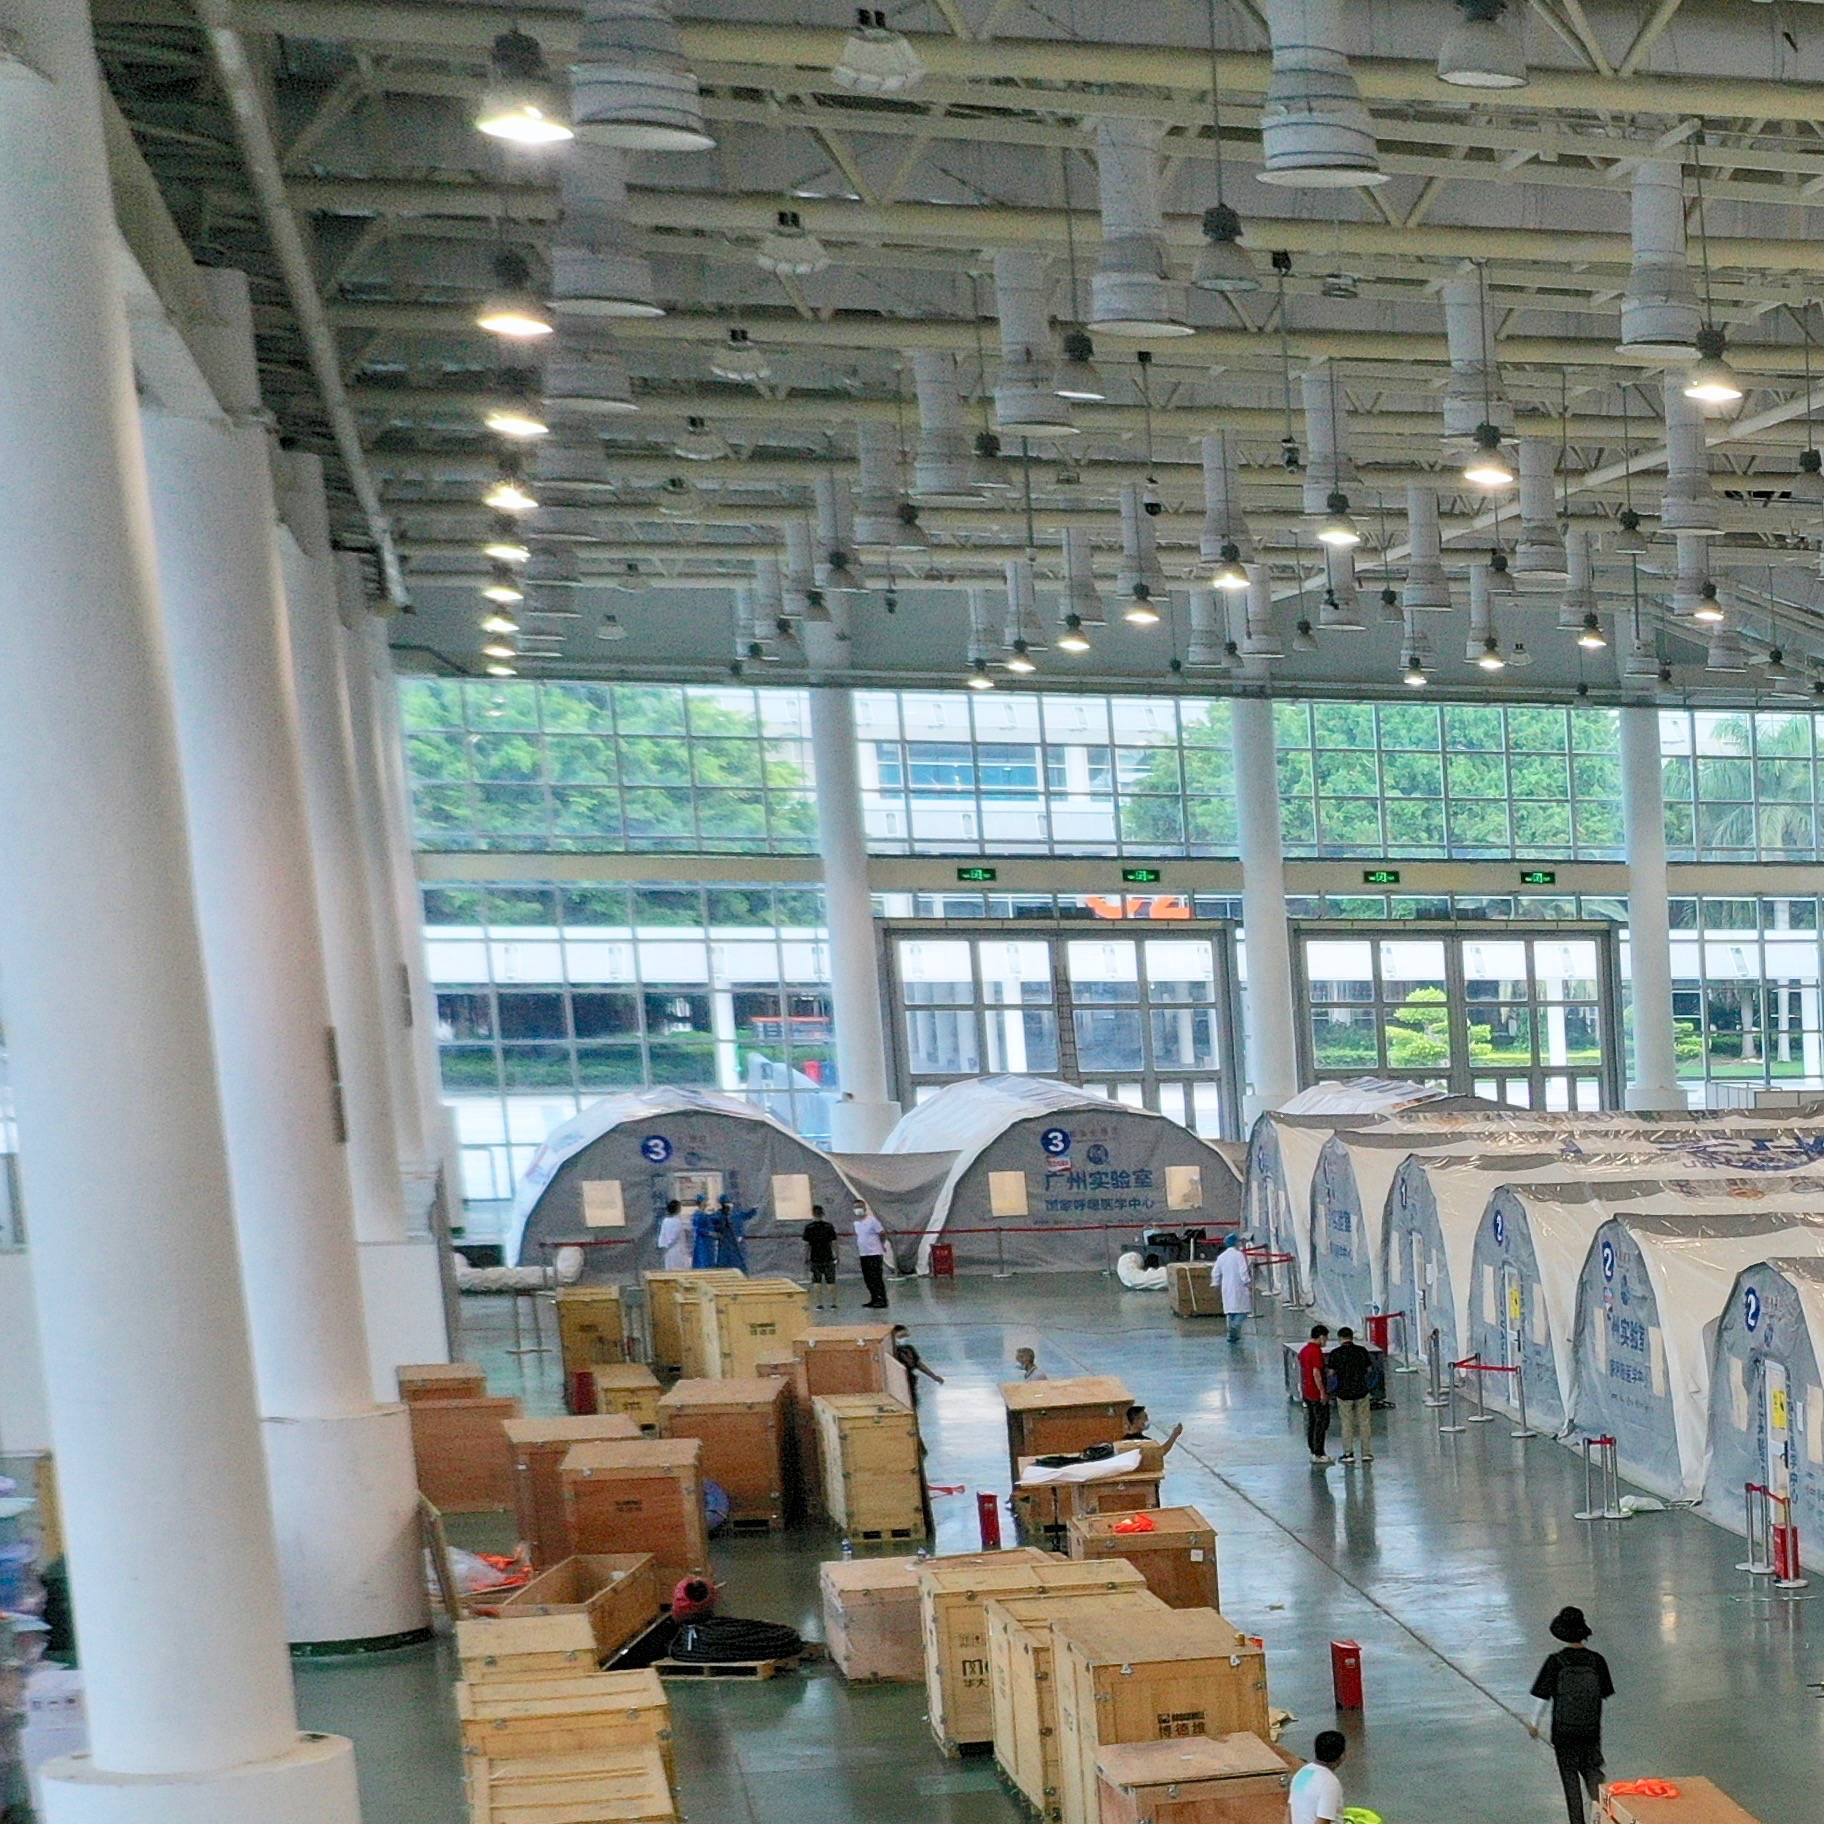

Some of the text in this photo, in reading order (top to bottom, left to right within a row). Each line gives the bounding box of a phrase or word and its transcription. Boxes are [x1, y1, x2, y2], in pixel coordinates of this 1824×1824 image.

[648, 1139, 666, 1160] 3
[1047, 1131, 1066, 1153] 3
[1044, 1168, 1153, 1191] 广州实验室
[1604, 1248, 1613, 1277] 2
[1748, 1294, 1757, 1327] 2
[1159, 1721, 1207, 1737] 博德维
